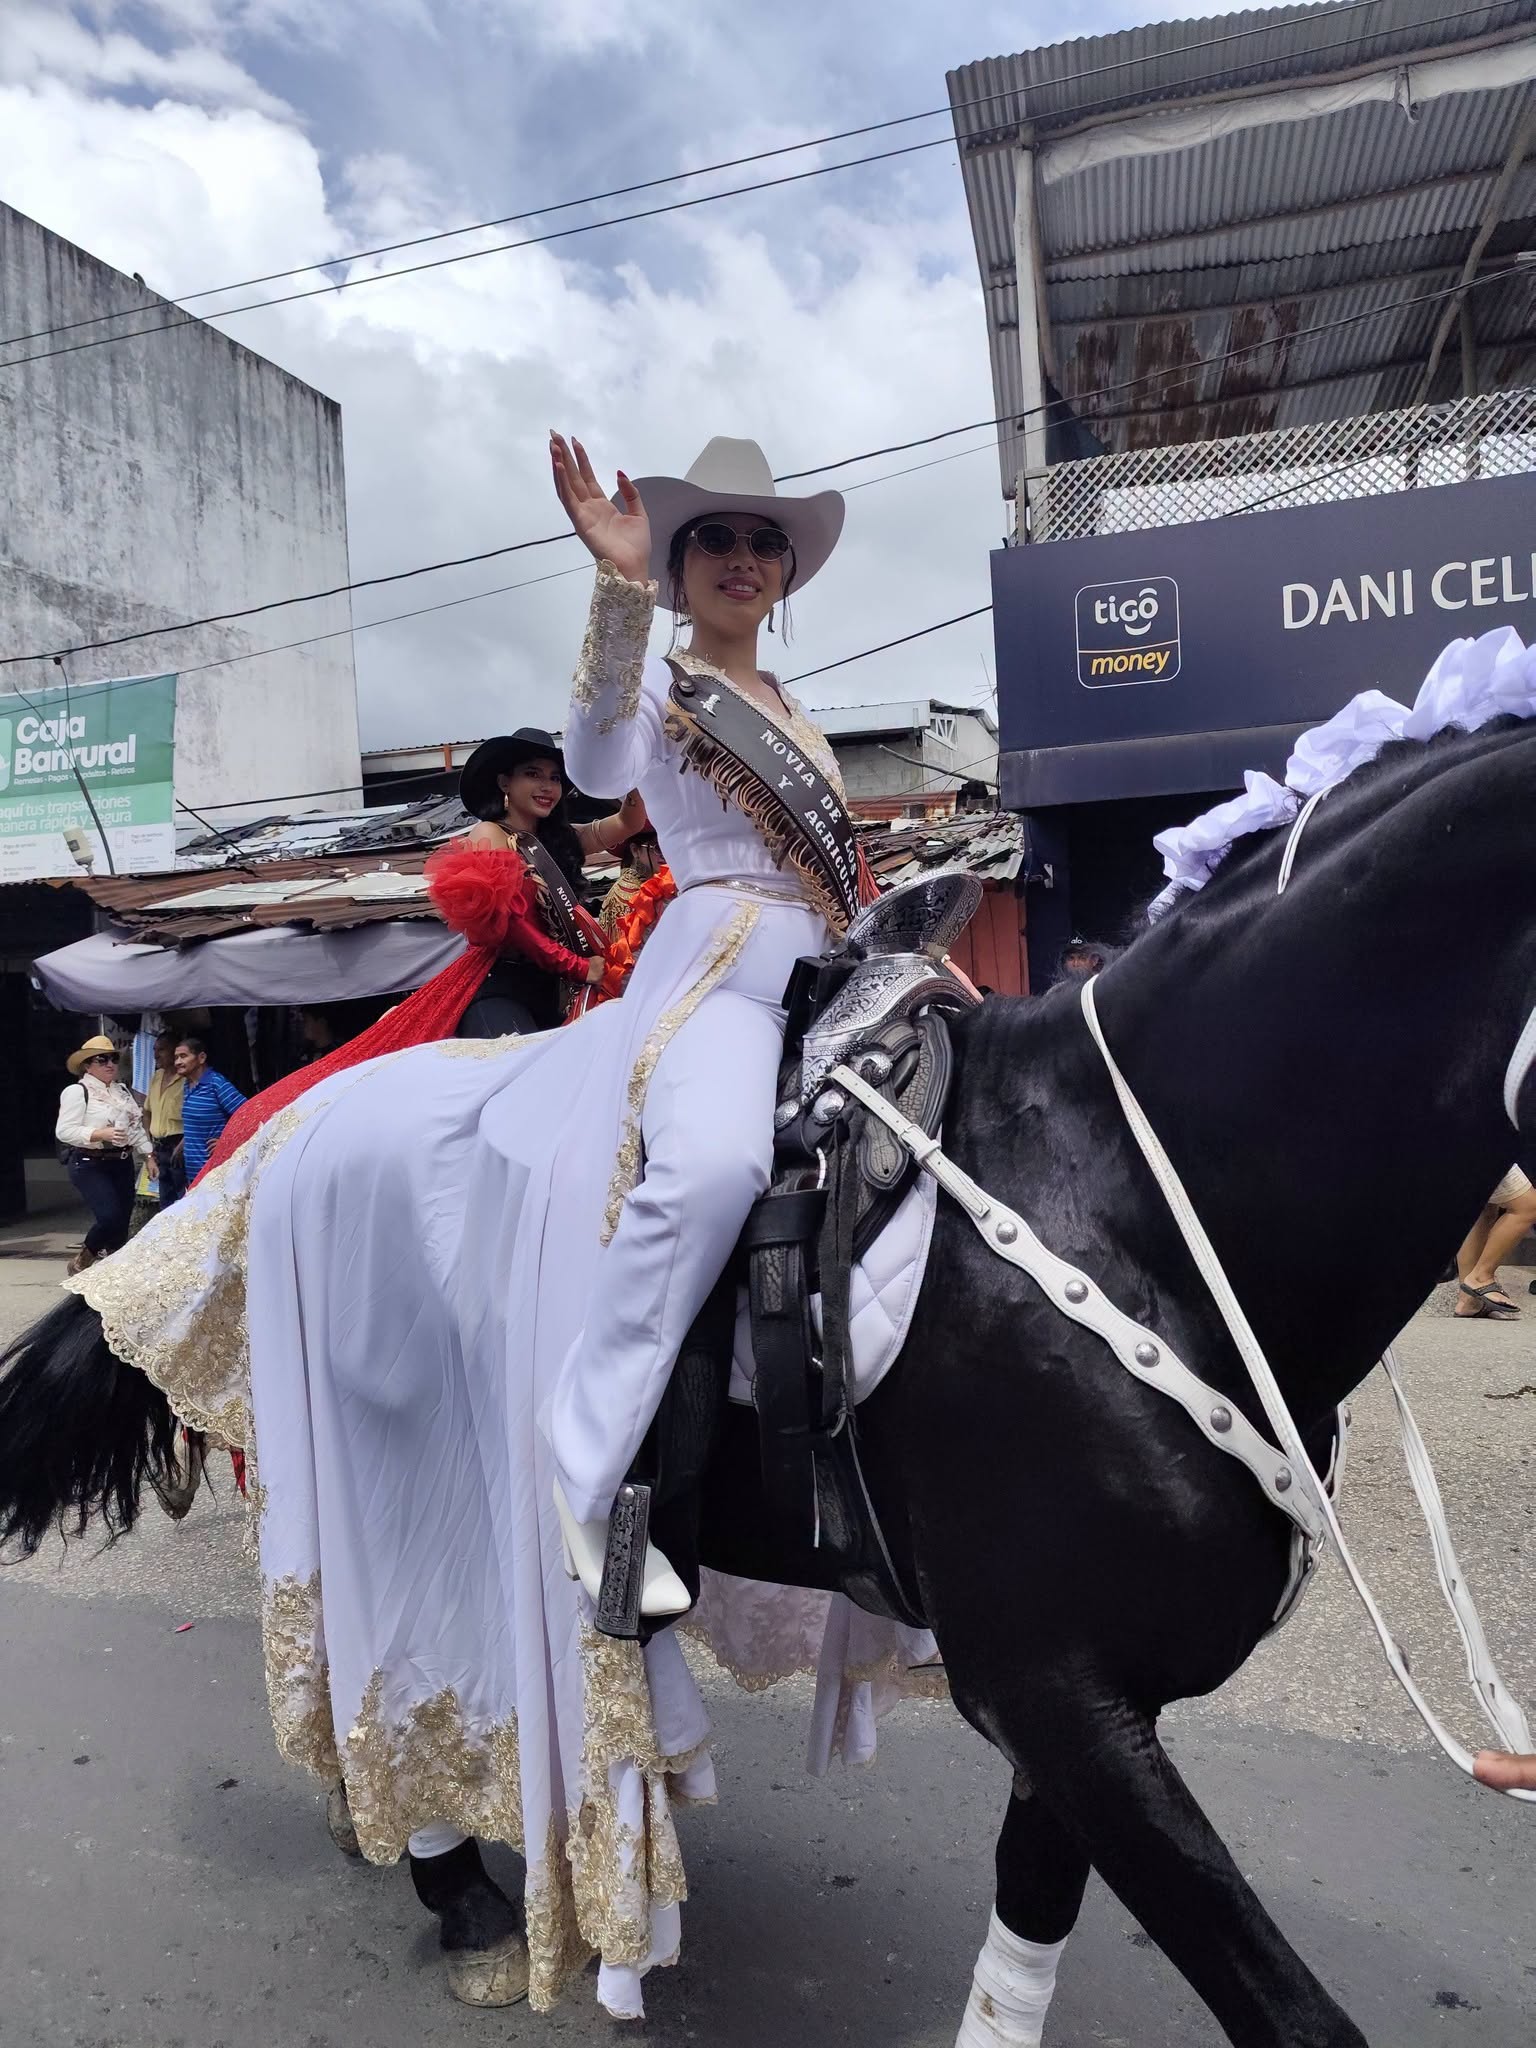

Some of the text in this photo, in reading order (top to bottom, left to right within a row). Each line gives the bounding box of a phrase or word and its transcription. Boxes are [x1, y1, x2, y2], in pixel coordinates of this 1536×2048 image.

[1282, 552, 1536, 630] DANI CEL
[1094, 587, 1159, 636] tigo
[1091, 650, 1171, 675] money
[16, 710, 86, 747] Caja
[14, 734, 137, 775] Banrural
[48, 774, 69, 783] Pagos
[778, 773, 794, 790] Y
[26, 802, 45, 817] tus
[759, 728, 857, 876] NOVIA DE LOS
[576, 929, 589, 952] DEL
